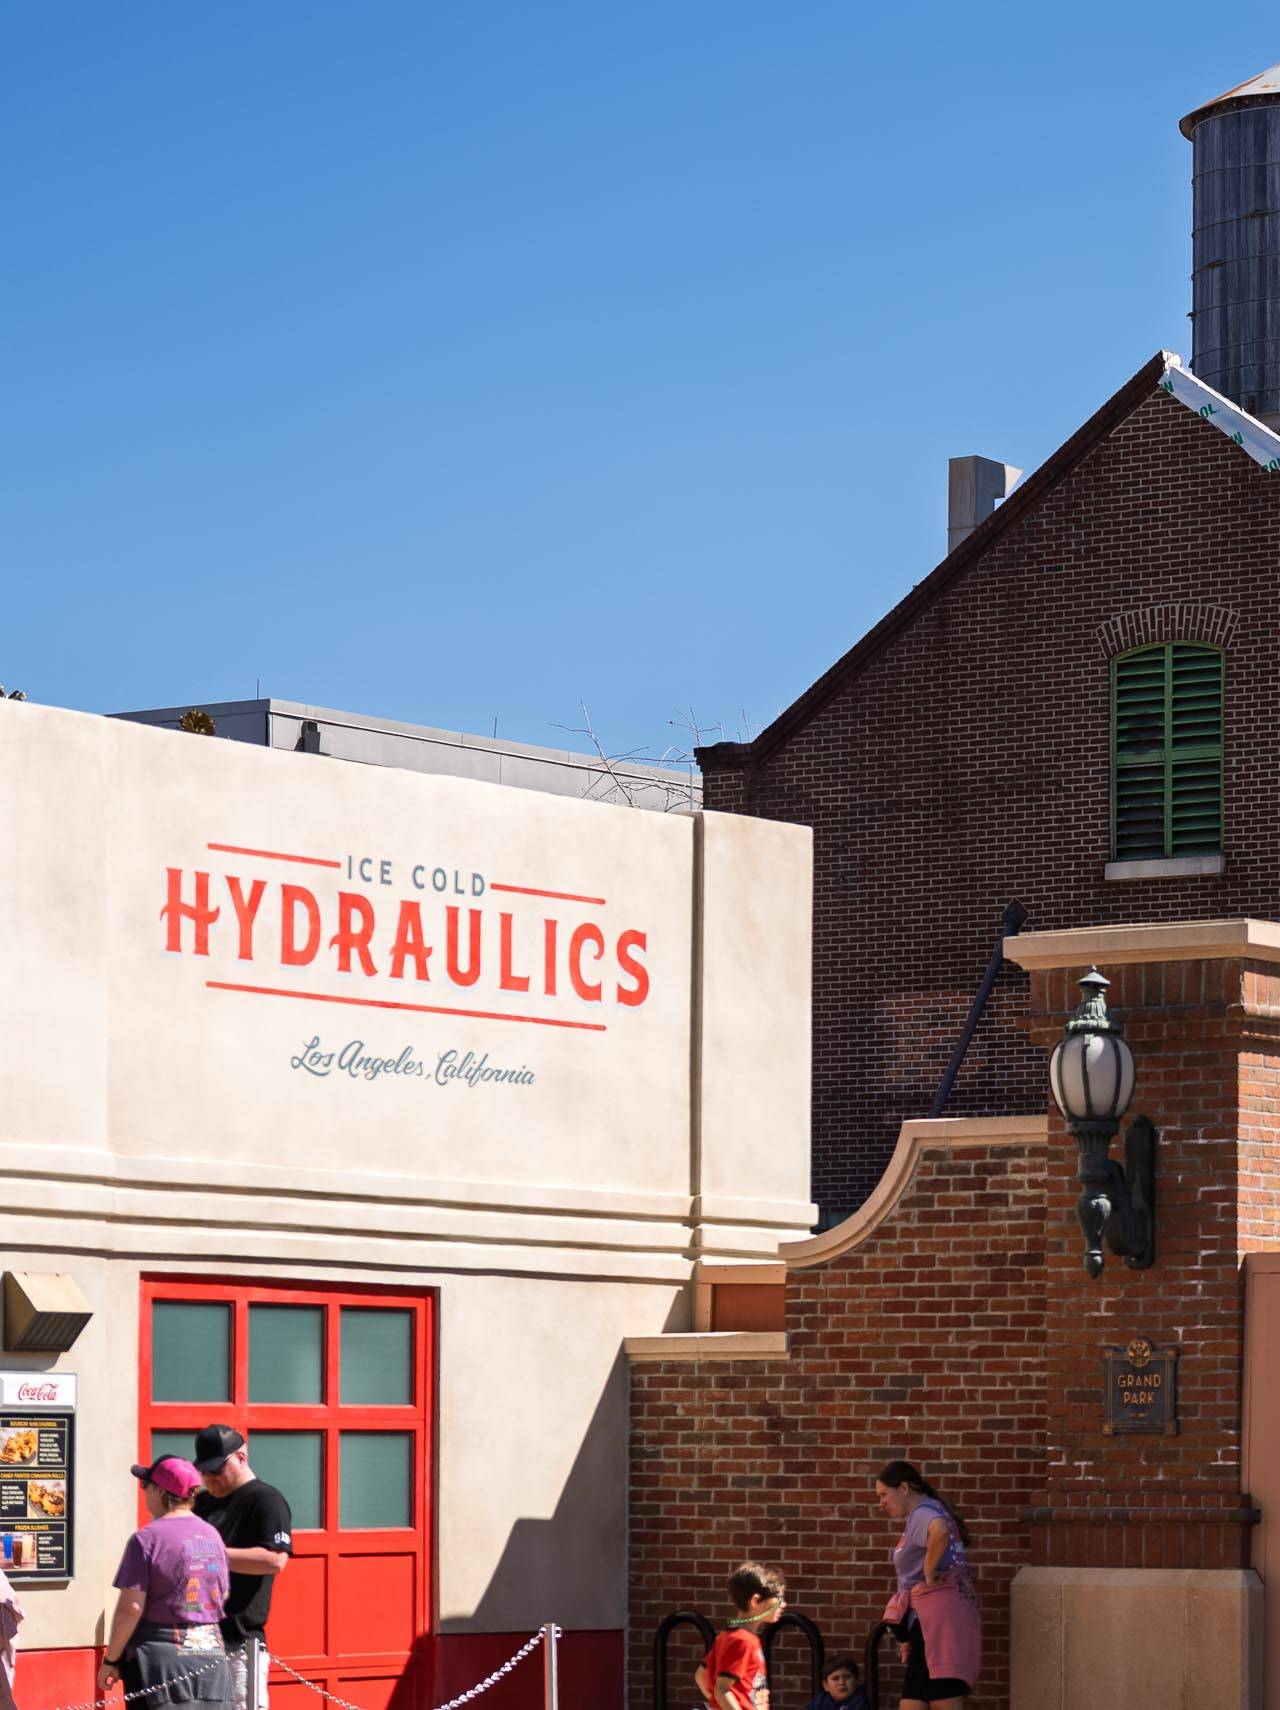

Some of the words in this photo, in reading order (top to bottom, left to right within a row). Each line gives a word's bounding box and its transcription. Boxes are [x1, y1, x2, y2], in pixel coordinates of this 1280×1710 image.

[347, 855, 393, 886] ICE
[412, 864, 486, 898] COLD
[160, 866, 650, 1007] HYDRAULICS
[290, 1035, 336, 1077] Los
[434, 1049, 536, 1089] California
[1117, 1374, 1161, 1388] GRAND
[1123, 1391, 1155, 1405] PARK
